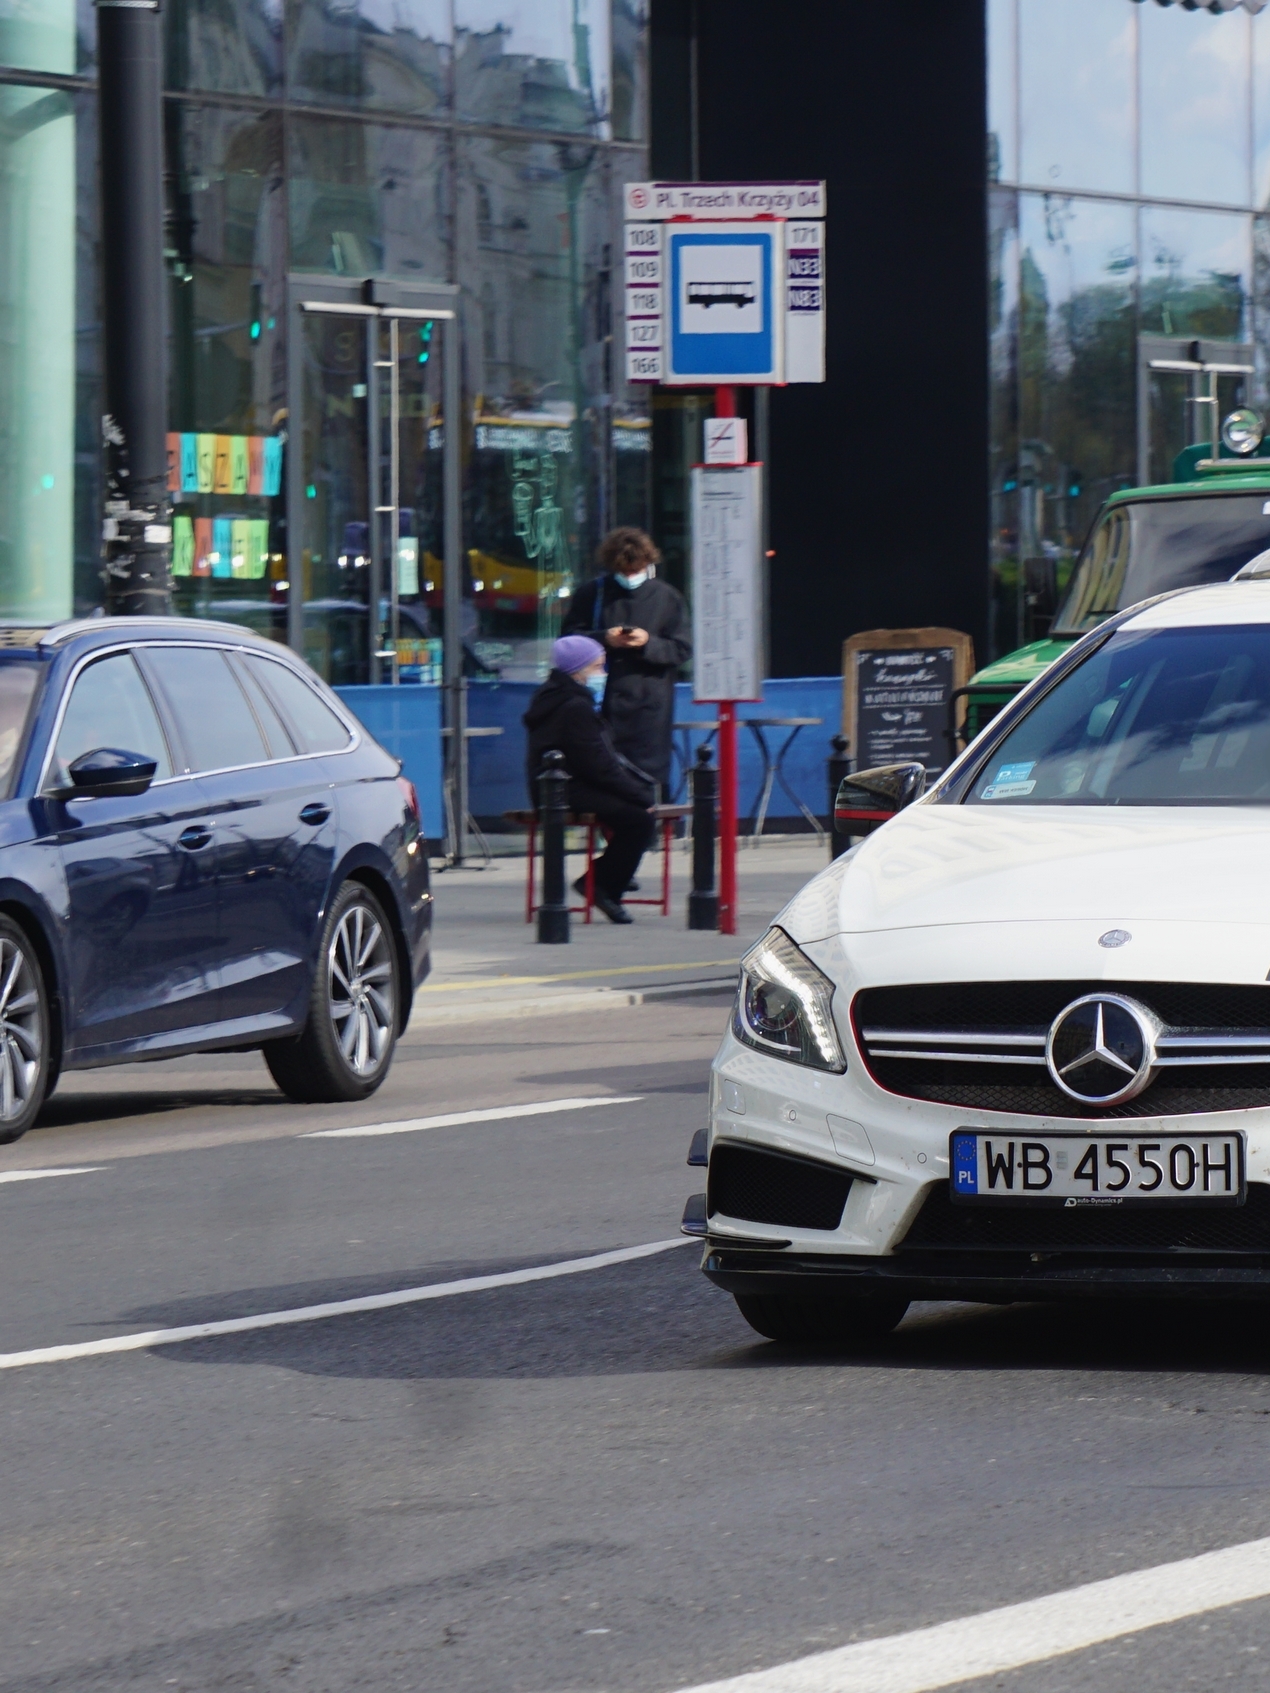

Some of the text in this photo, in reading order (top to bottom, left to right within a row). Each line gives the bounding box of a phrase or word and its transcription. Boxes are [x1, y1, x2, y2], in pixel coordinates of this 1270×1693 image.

[655, 191, 676, 208] Pl.
[680, 191, 731, 208] Trzech
[737, 190, 794, 211] Krzyży
[797, 191, 820, 207] 04
[629, 229, 659, 246] 108
[791, 227, 818, 244] 171
[630, 261, 659, 278] 109
[790, 257, 819, 275] N33
[632, 293, 659, 310] 118
[631, 325, 659, 342] 127
[631, 357, 659, 374] 166
[958, 1140, 1232, 1192] PL WB 4550H
